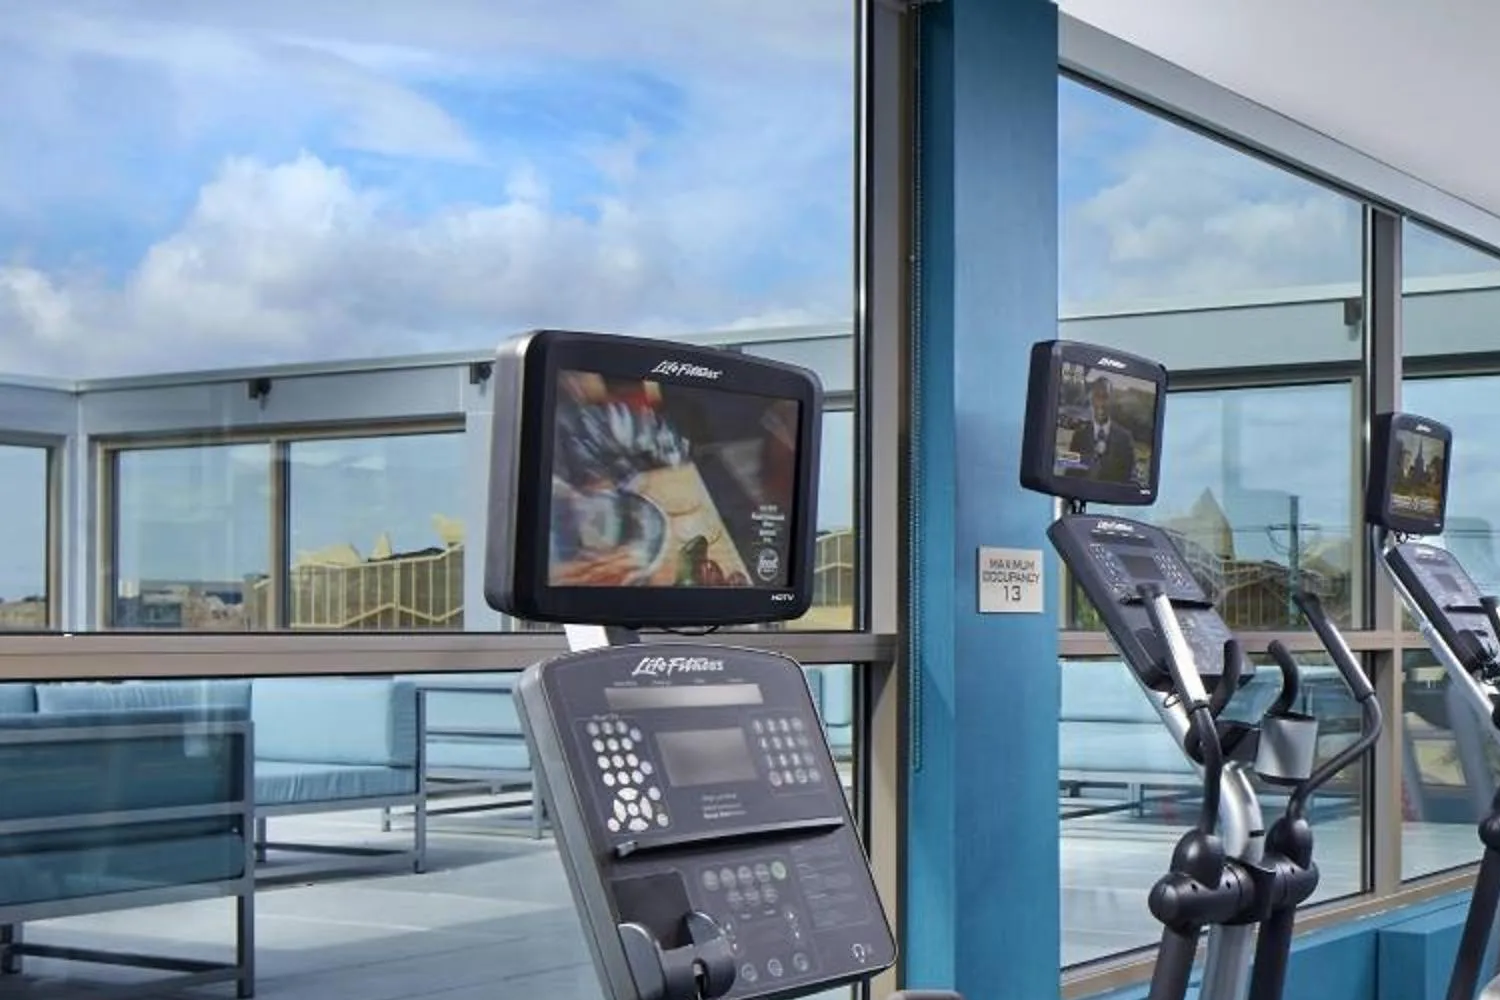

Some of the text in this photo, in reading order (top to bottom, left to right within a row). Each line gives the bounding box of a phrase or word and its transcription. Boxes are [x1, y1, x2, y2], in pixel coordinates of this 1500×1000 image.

[985, 558, 1035, 570] MAXIMUM
[982, 571, 1039, 584] OCCUPANCY
[1003, 585, 1021, 601] 13
[631, 657, 667, 676] Life
